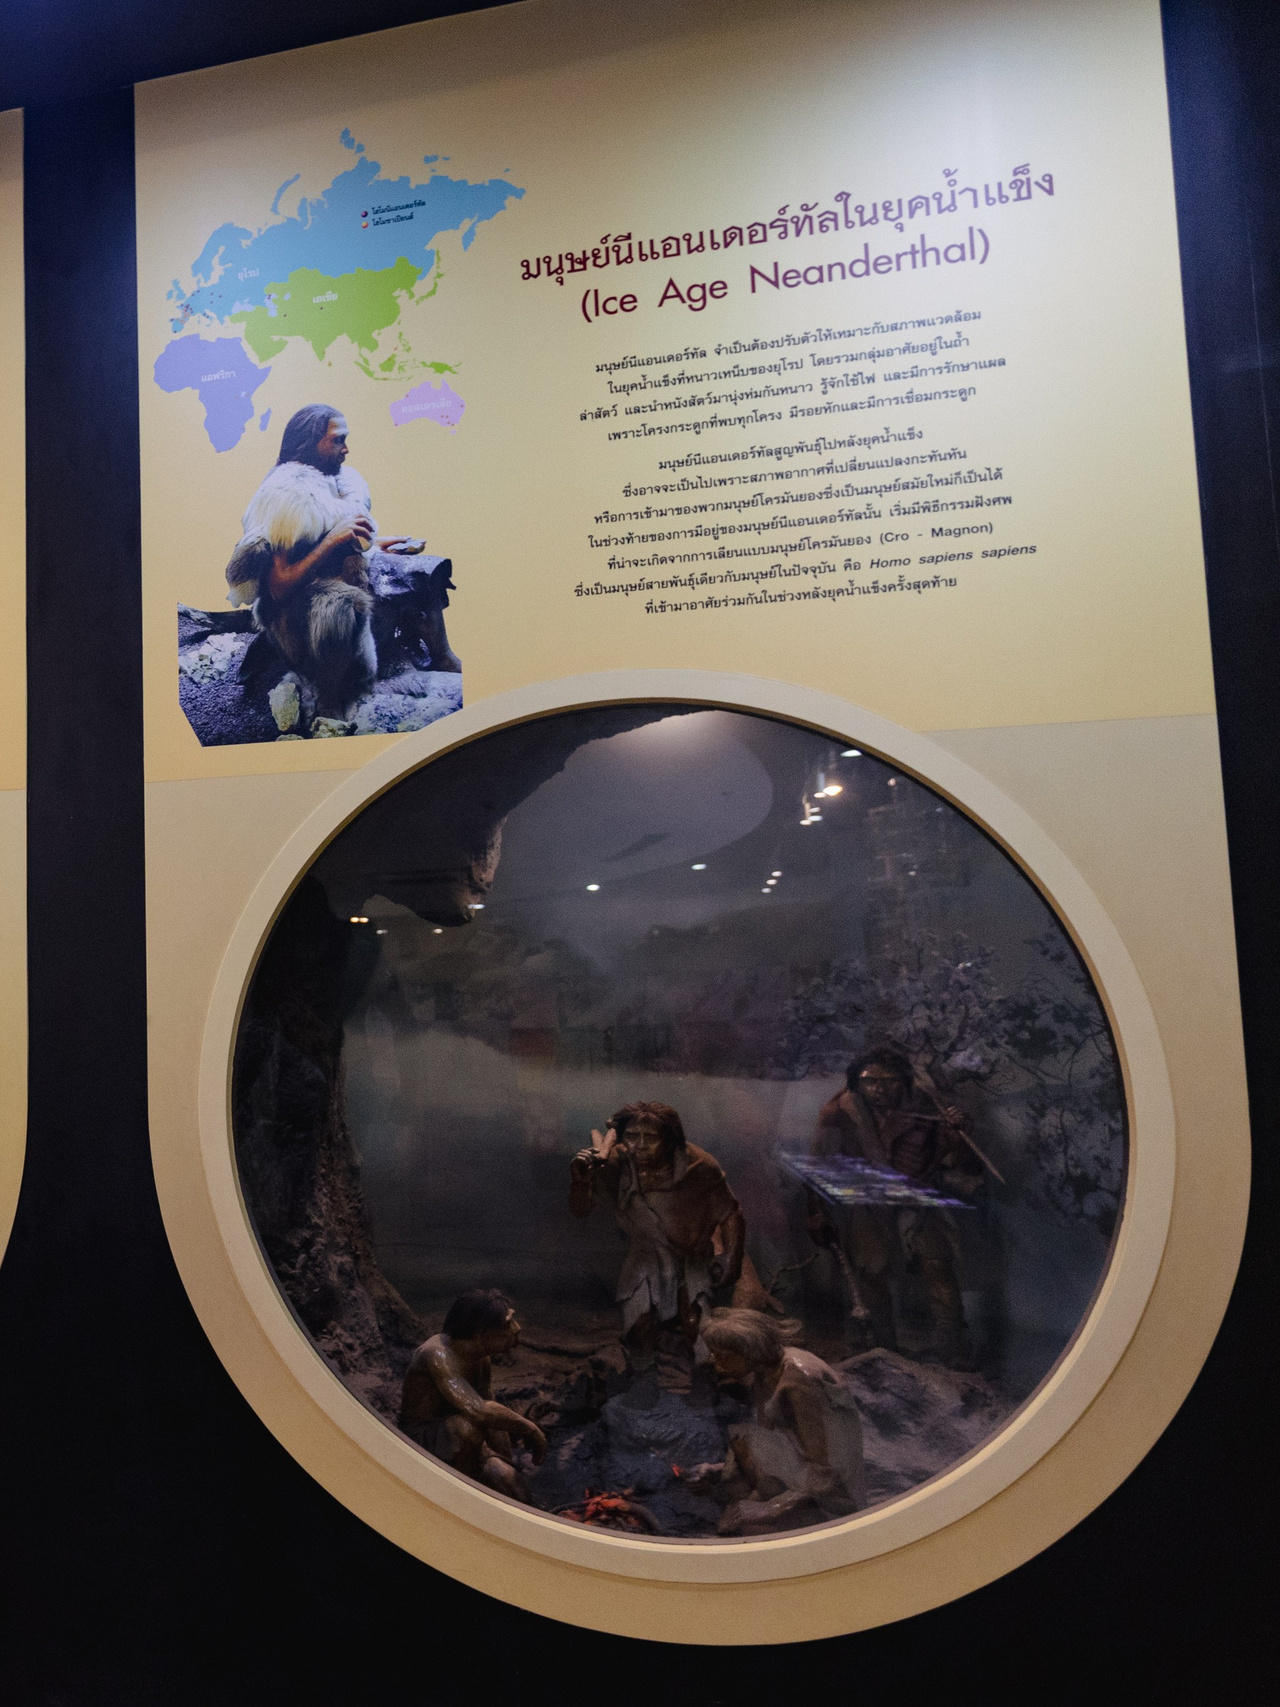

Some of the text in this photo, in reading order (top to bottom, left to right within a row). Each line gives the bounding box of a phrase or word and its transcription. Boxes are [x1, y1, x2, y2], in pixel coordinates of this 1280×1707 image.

[519, 162, 1057, 285] มนุษย์นีแอนเดอร์ทัลในยุคน้ำแข็ง
[580, 228, 990, 323] (Ice Age Neanderthal)
[578, 403, 619, 422] ล่าสัตว์
[819, 370, 876, 396] รู้จักใช้ไฟ
[842, 557, 862, 572] คือ
[868, 557, 912, 569] Homo
[918, 551, 974, 565] sapiens
[980, 544, 1038, 559] sapiens
[878, 531, 910, 545] (Cro
[930, 521, 994, 539] Magnon)
